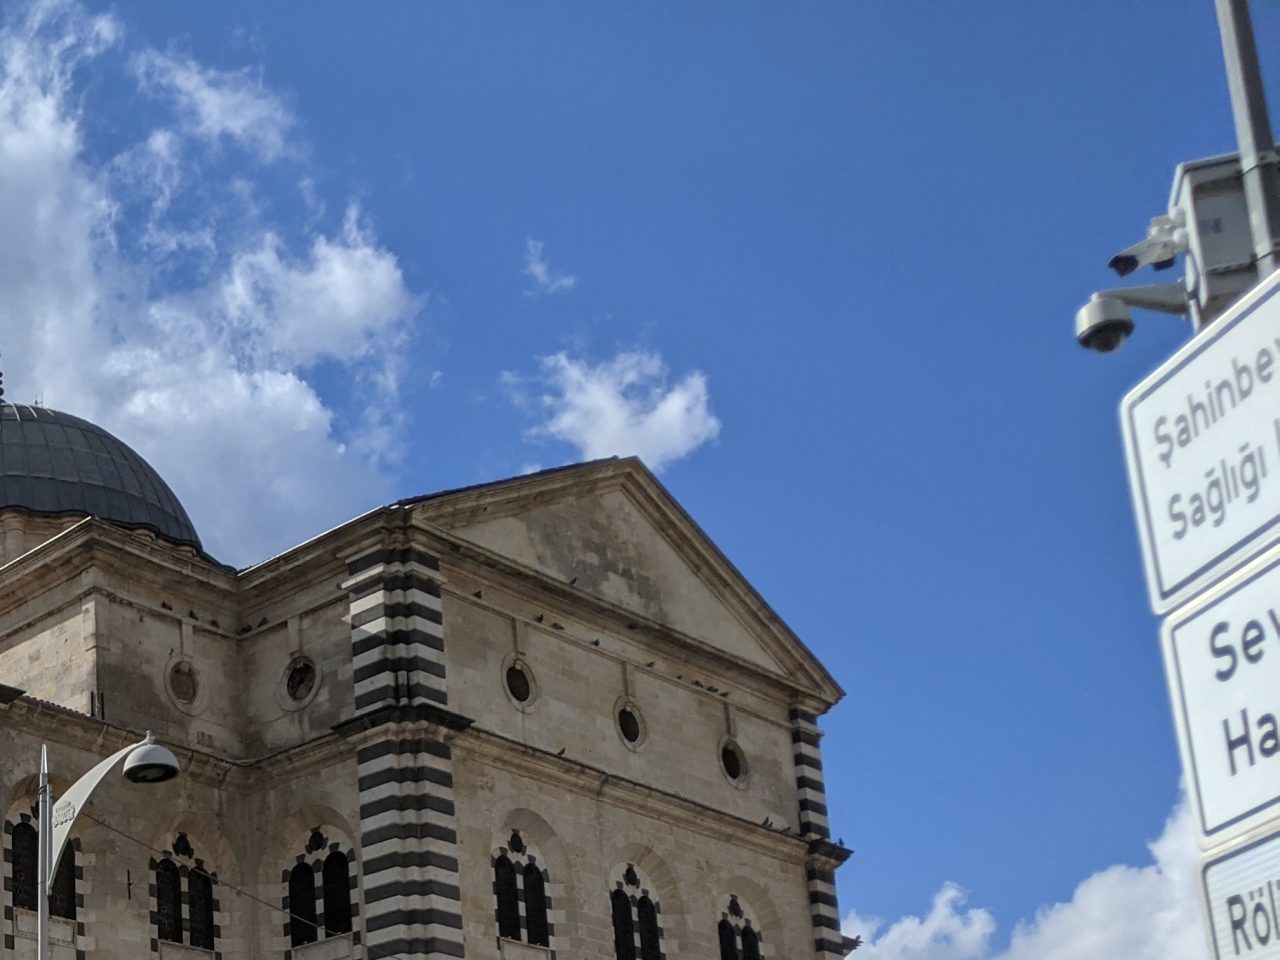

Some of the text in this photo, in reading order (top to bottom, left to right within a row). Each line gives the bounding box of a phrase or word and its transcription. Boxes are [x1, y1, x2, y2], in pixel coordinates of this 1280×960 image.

[1154, 336, 1280, 469] Şahinbe
[1169, 442, 1268, 541] Sağlığı
[1226, 880, 1280, 956] Röl
